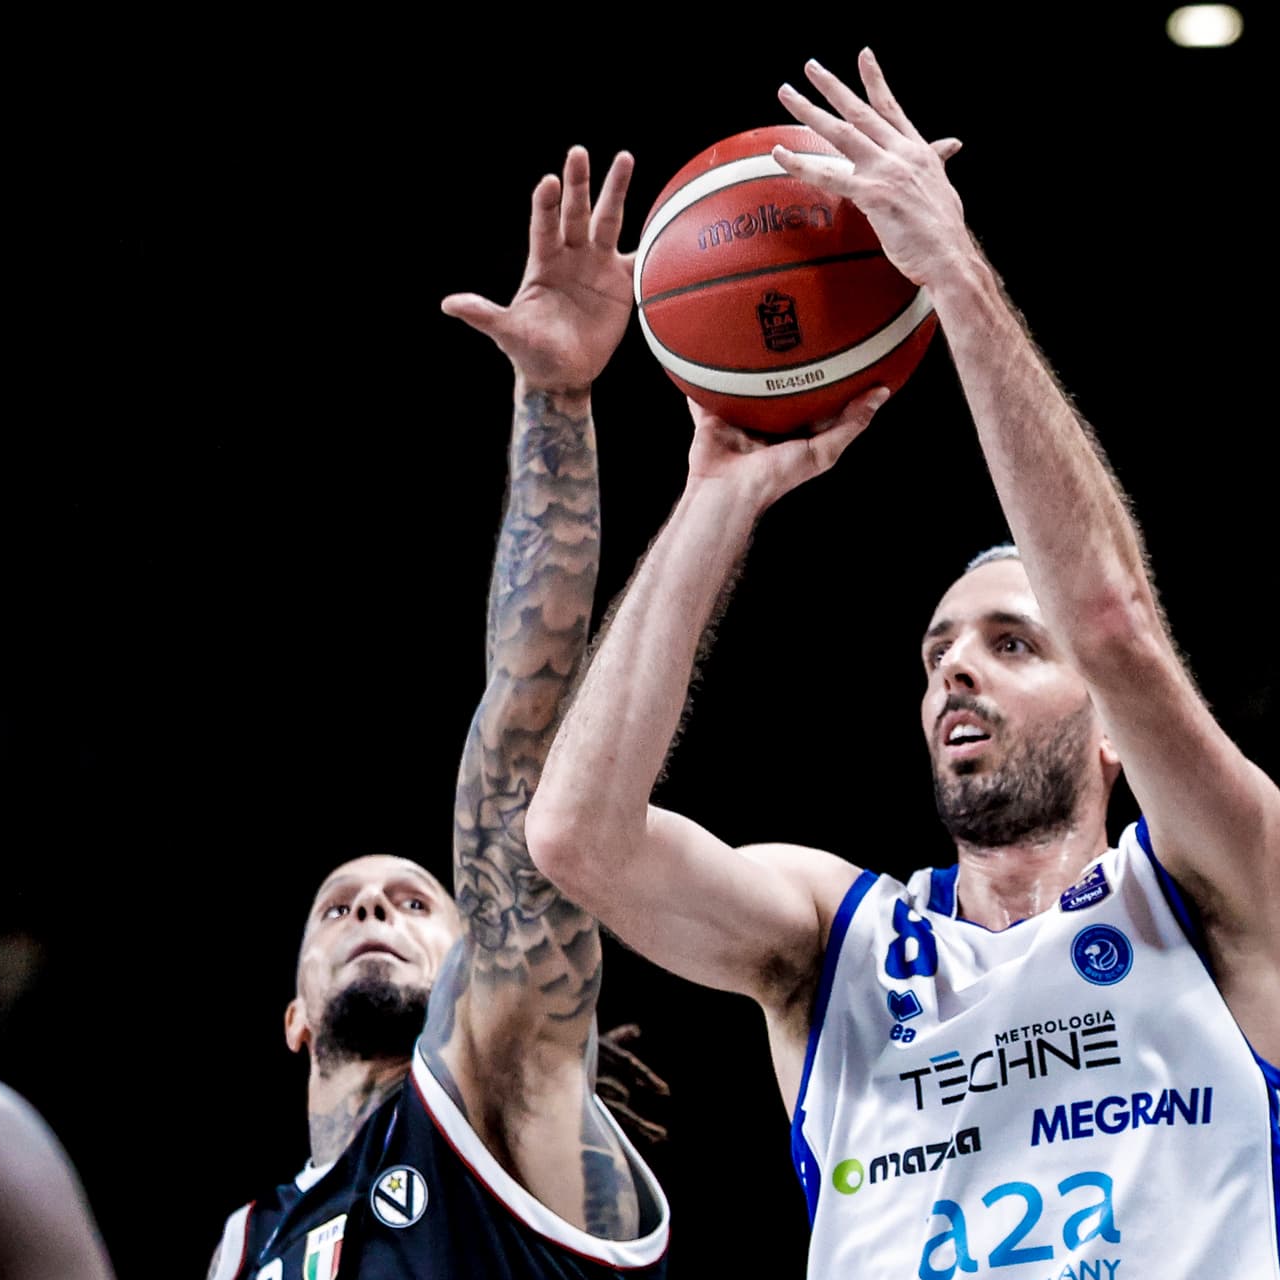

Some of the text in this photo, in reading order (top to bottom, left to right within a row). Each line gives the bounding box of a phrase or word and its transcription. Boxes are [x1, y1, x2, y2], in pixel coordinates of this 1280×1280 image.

[697, 203, 833, 250] molten
[885, 897, 938, 979] 8
[995, 1009, 1116, 1047] METROLOGIA
[899, 1022, 1121, 1111] TECHNE
[1030, 1086, 1214, 1147] MEGRANI
